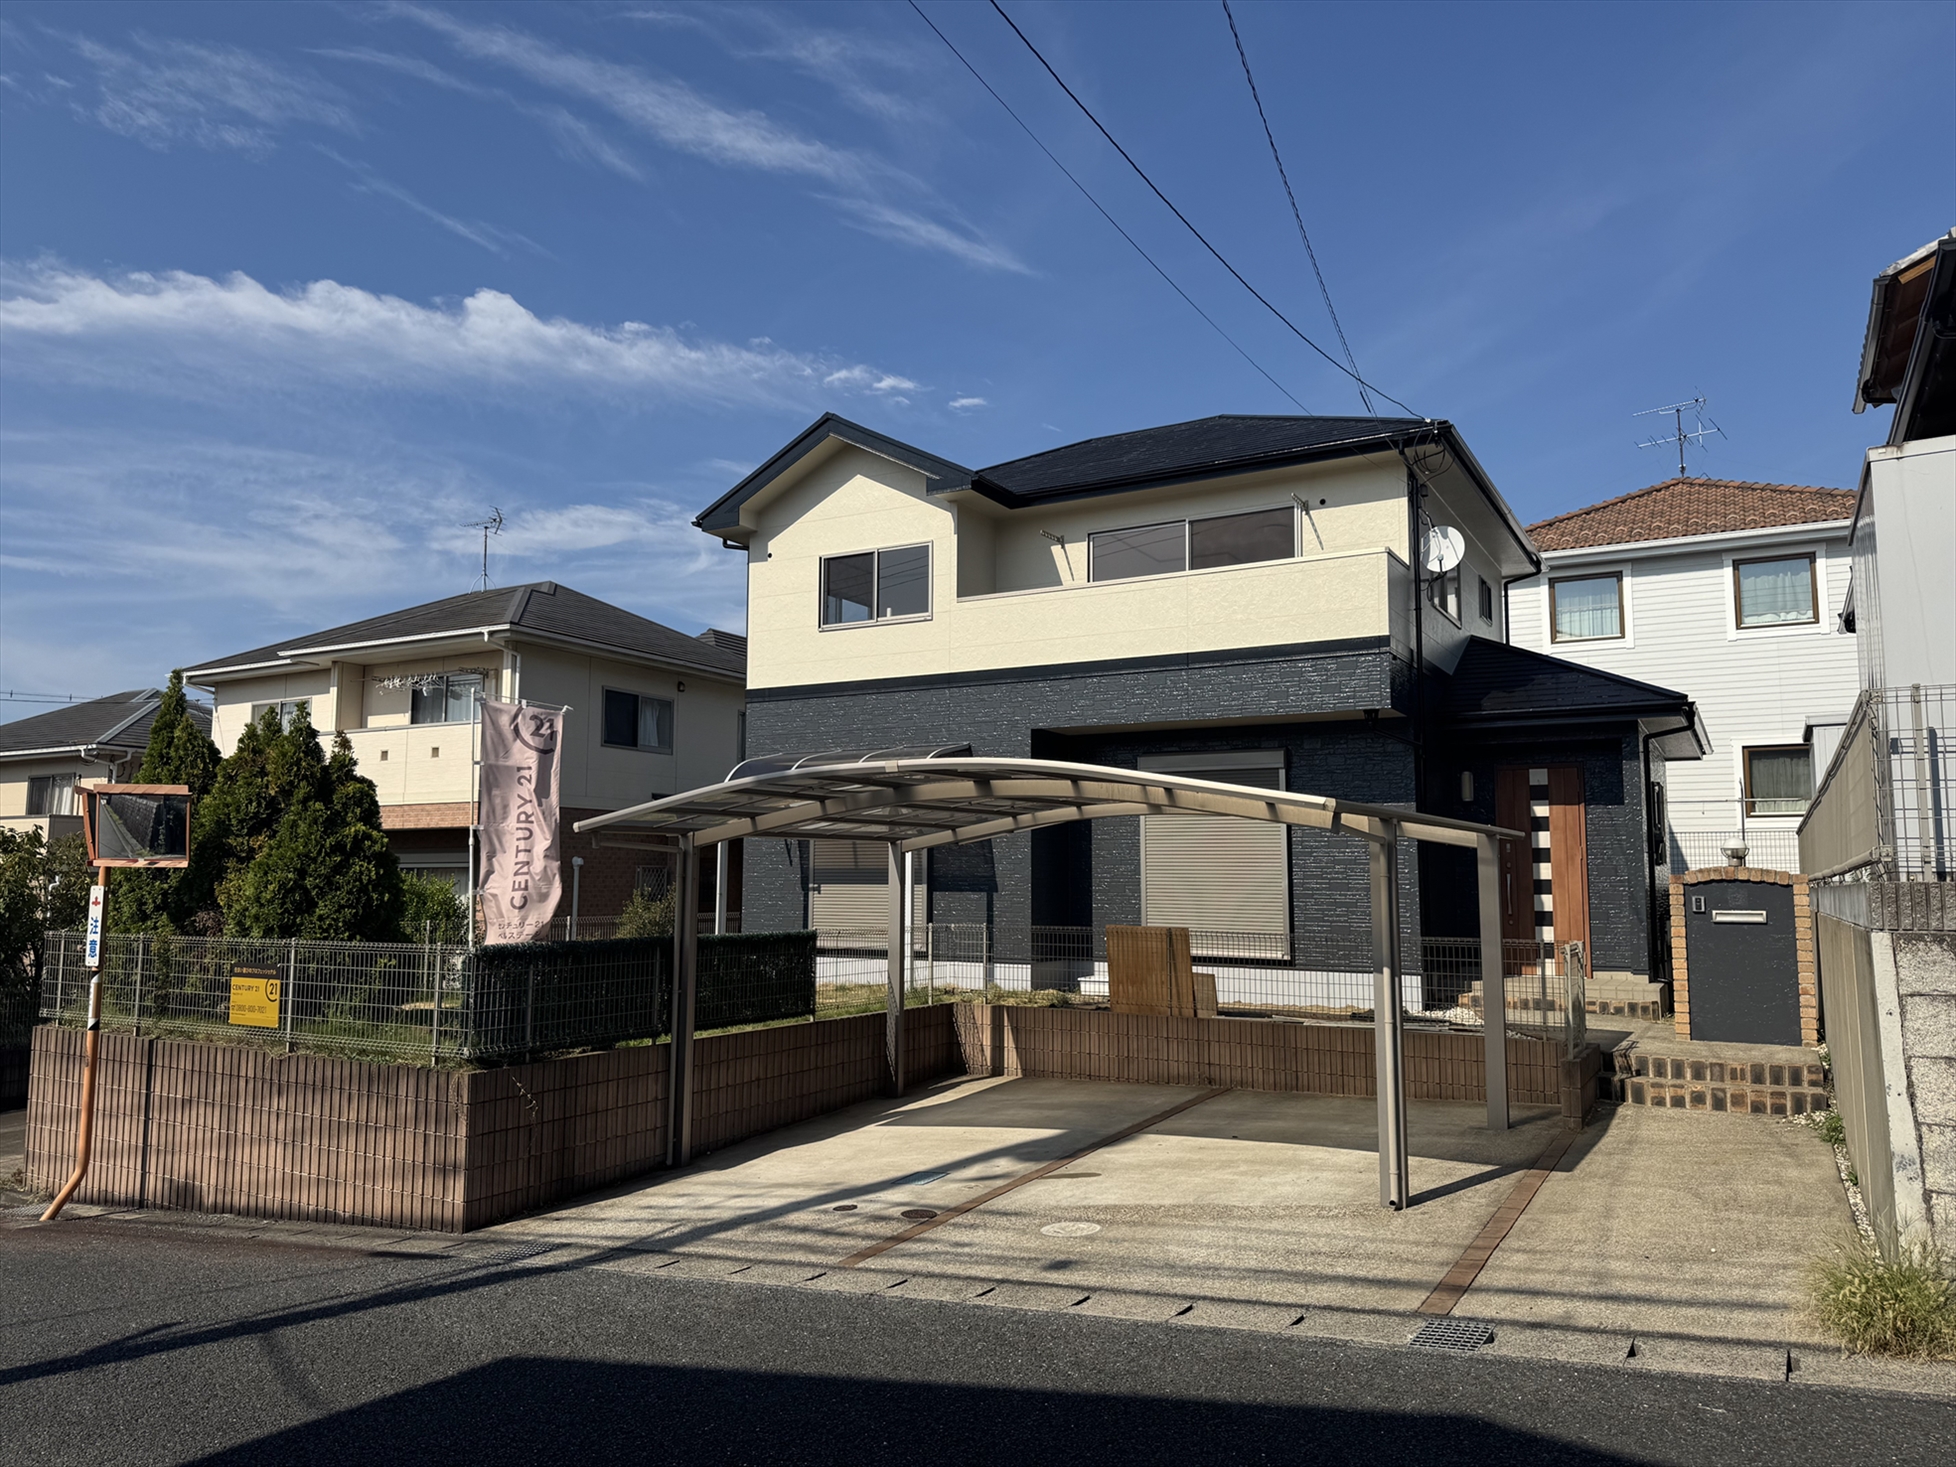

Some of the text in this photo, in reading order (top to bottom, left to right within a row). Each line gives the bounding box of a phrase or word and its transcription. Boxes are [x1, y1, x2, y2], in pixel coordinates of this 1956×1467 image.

[529, 714, 555, 741] 21
[510, 766, 535, 910] CENTURY 21
[88, 916, 99, 959] 注意
[269, 983, 278, 995] 21
